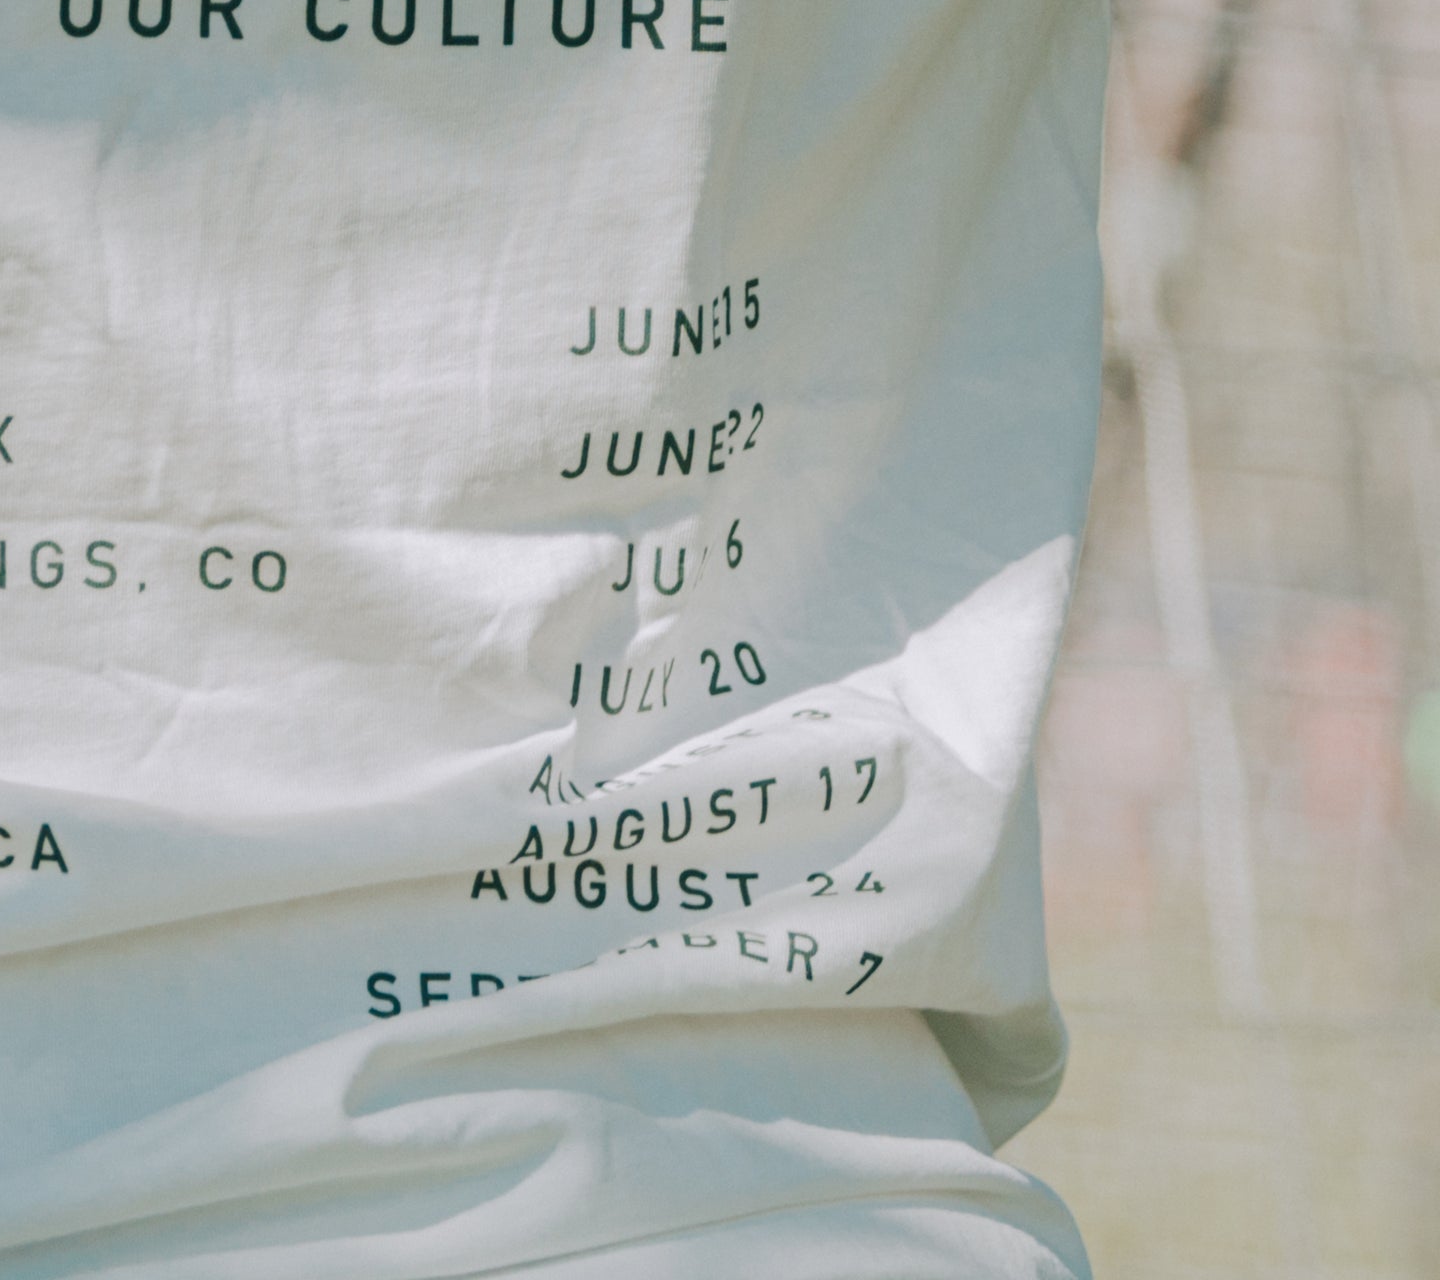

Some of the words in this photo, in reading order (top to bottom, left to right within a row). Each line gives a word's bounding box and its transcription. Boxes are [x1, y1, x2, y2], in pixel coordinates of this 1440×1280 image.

[568, 295, 723, 359] JUNE
[721, 276, 761, 338] 15
[559, 419, 728, 481] JUNE
[197, 544, 289, 595] CO
[724, 517, 745, 571] 6
[698, 639, 769, 698] 20
[508, 778, 777, 865] AUGUST
[818, 755, 879, 813] 17
[469, 857, 761, 914] AUGUST
[805, 870, 887, 899] 24
[844, 949, 885, 997] 7
